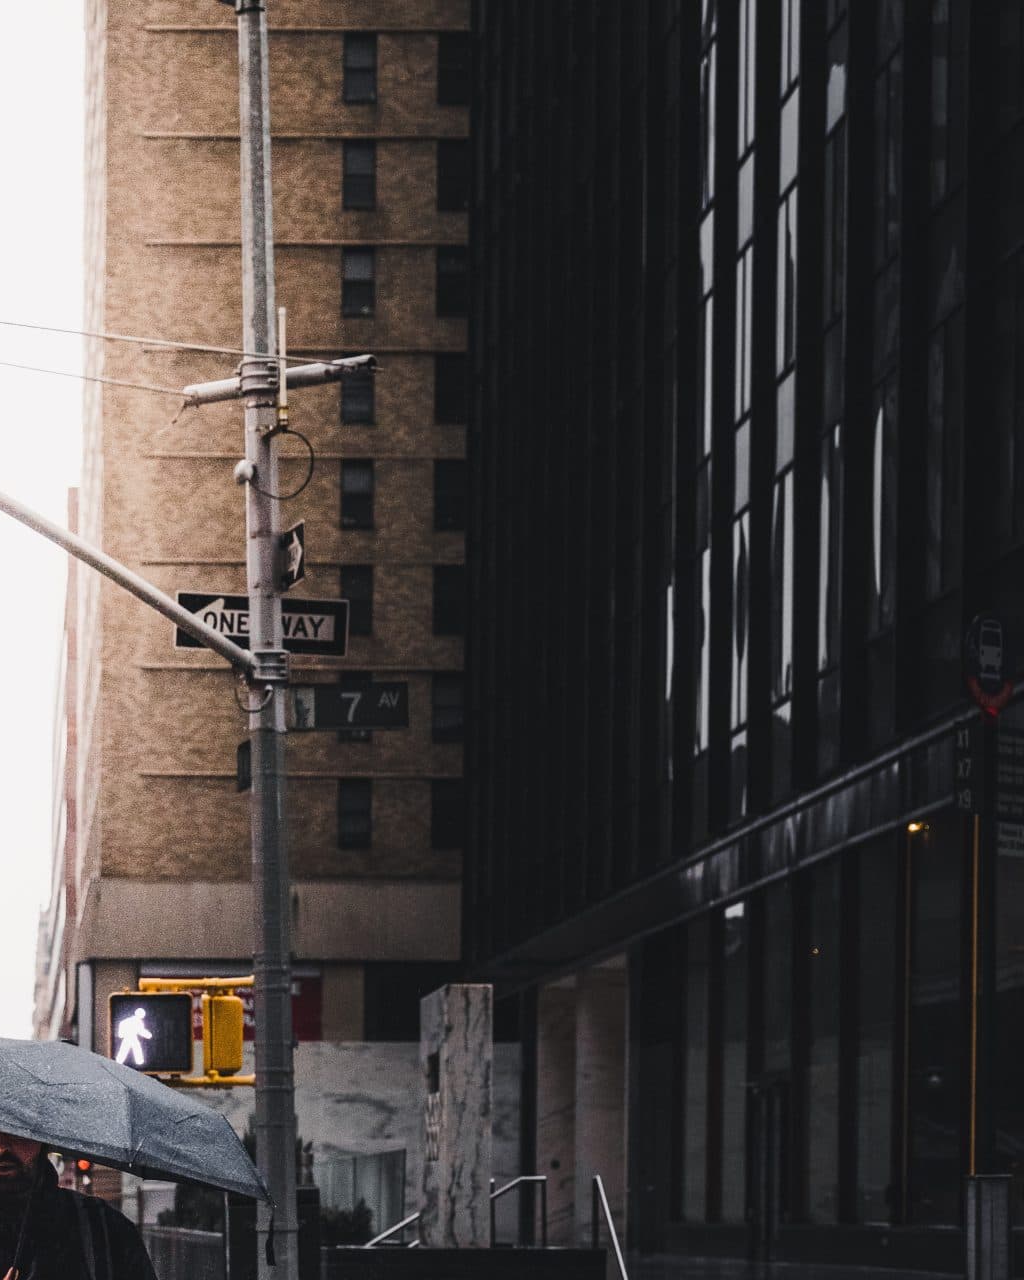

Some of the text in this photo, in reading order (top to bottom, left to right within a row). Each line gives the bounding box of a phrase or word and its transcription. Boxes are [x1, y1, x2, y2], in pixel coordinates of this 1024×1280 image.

[204, 611, 250, 634] ONE
[340, 690, 401, 723] 7 AV
